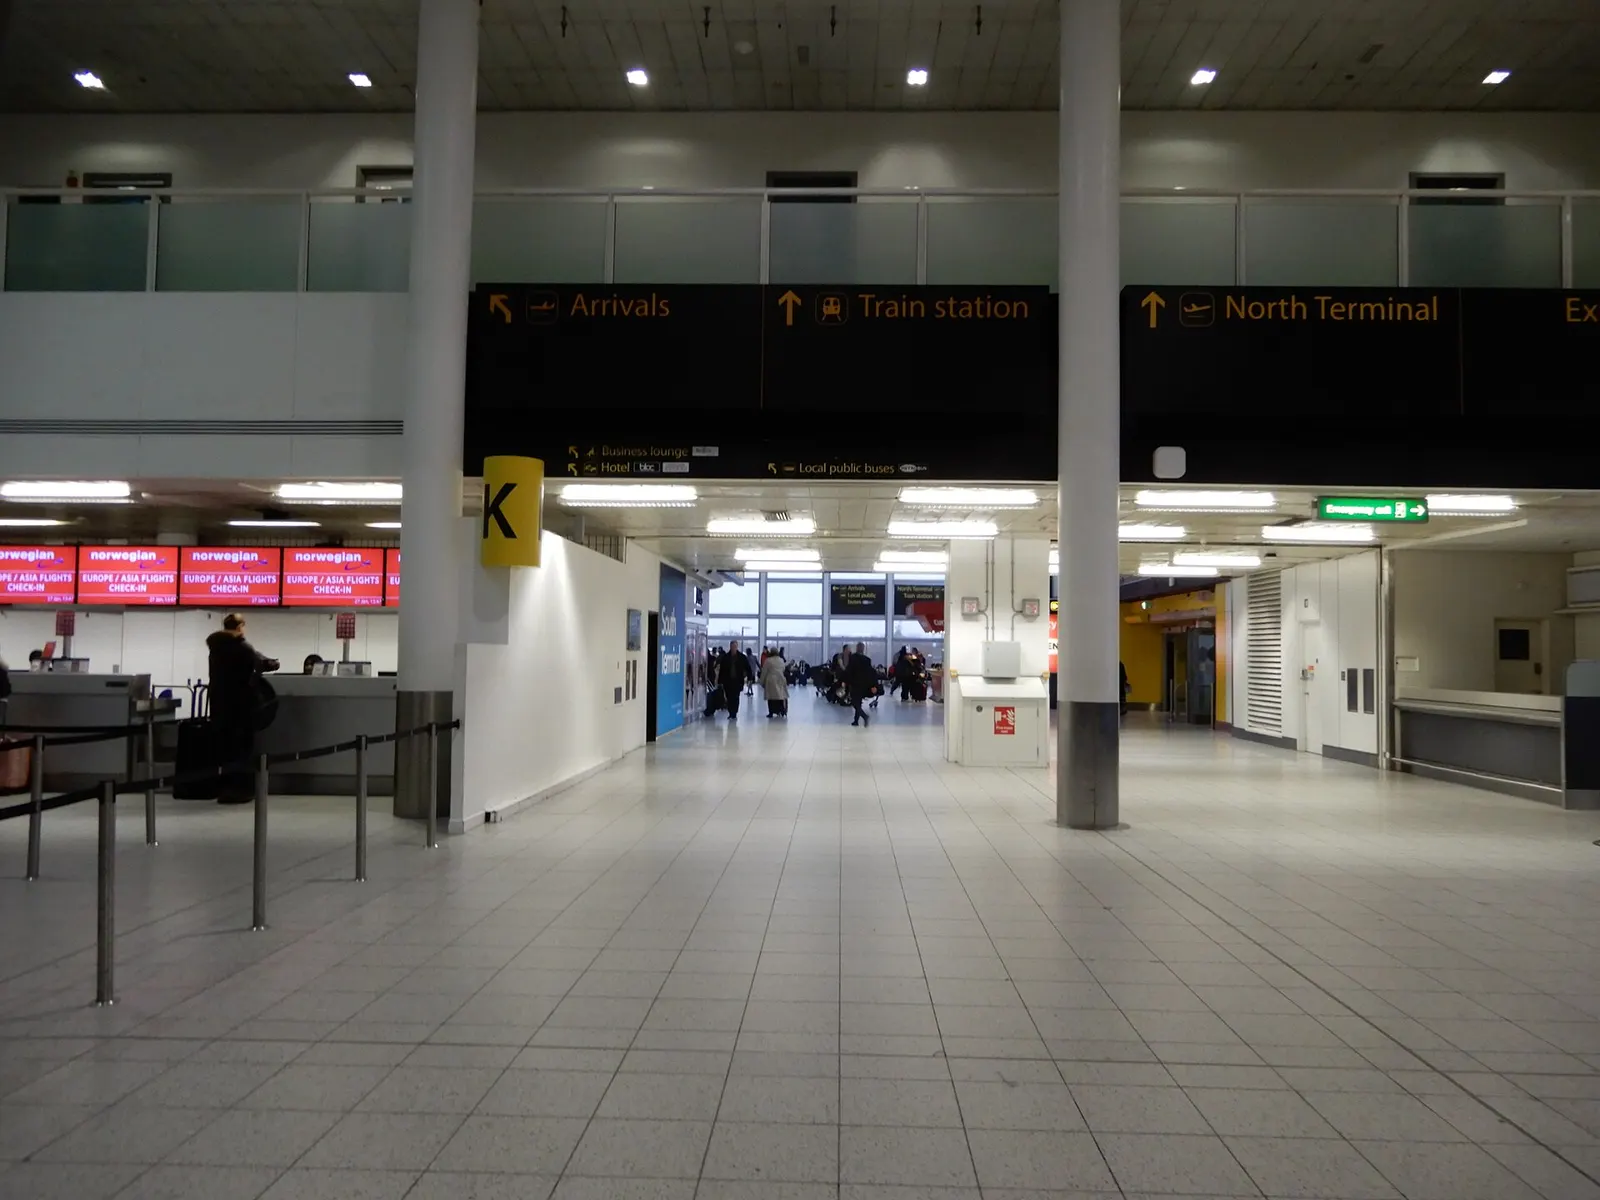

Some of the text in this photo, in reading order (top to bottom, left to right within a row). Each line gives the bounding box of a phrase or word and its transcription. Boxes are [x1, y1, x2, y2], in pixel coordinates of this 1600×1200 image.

[570, 293, 670, 318] Arrivals
[859, 294, 1029, 320] Train station
[1226, 296, 1438, 321] North Terminal
[601, 445, 648, 457] Business
[651, 445, 689, 459] lounge
[601, 461, 630, 472] Hotel
[800, 462, 826, 473] Local
[829, 462, 860, 475] public
[865, 462, 895, 473] buses
[483, 483, 518, 539] K
[90, 550, 157, 563] norwegian
[192, 551, 258, 564] norwegian
[295, 552, 362, 563] norwegian
[19, 573, 38, 582] ASIA
[39, 573, 73, 582] FLIGHTS
[82, 573, 113, 583] EUROPE
[121, 574, 139, 583] ASIA
[142, 574, 174, 583] FLIGHTS
[184, 574, 215, 583] EUROPE
[224, 574, 241, 583] ASIA
[244, 574, 276, 583] FLIGHTS
[287, 575, 317, 584] EUROPE
[326, 575, 344, 584] ASIA
[347, 575, 380, 584] FLIGHTS
[7, 583, 45, 592] CHECK-IN
[109, 583, 147, 592] CHECK-IN
[211, 584, 249, 593] CHECK-IN
[314, 585, 352, 594] CHECK-IN
[661, 605, 677, 637] South
[660, 644, 681, 675] Terminal
